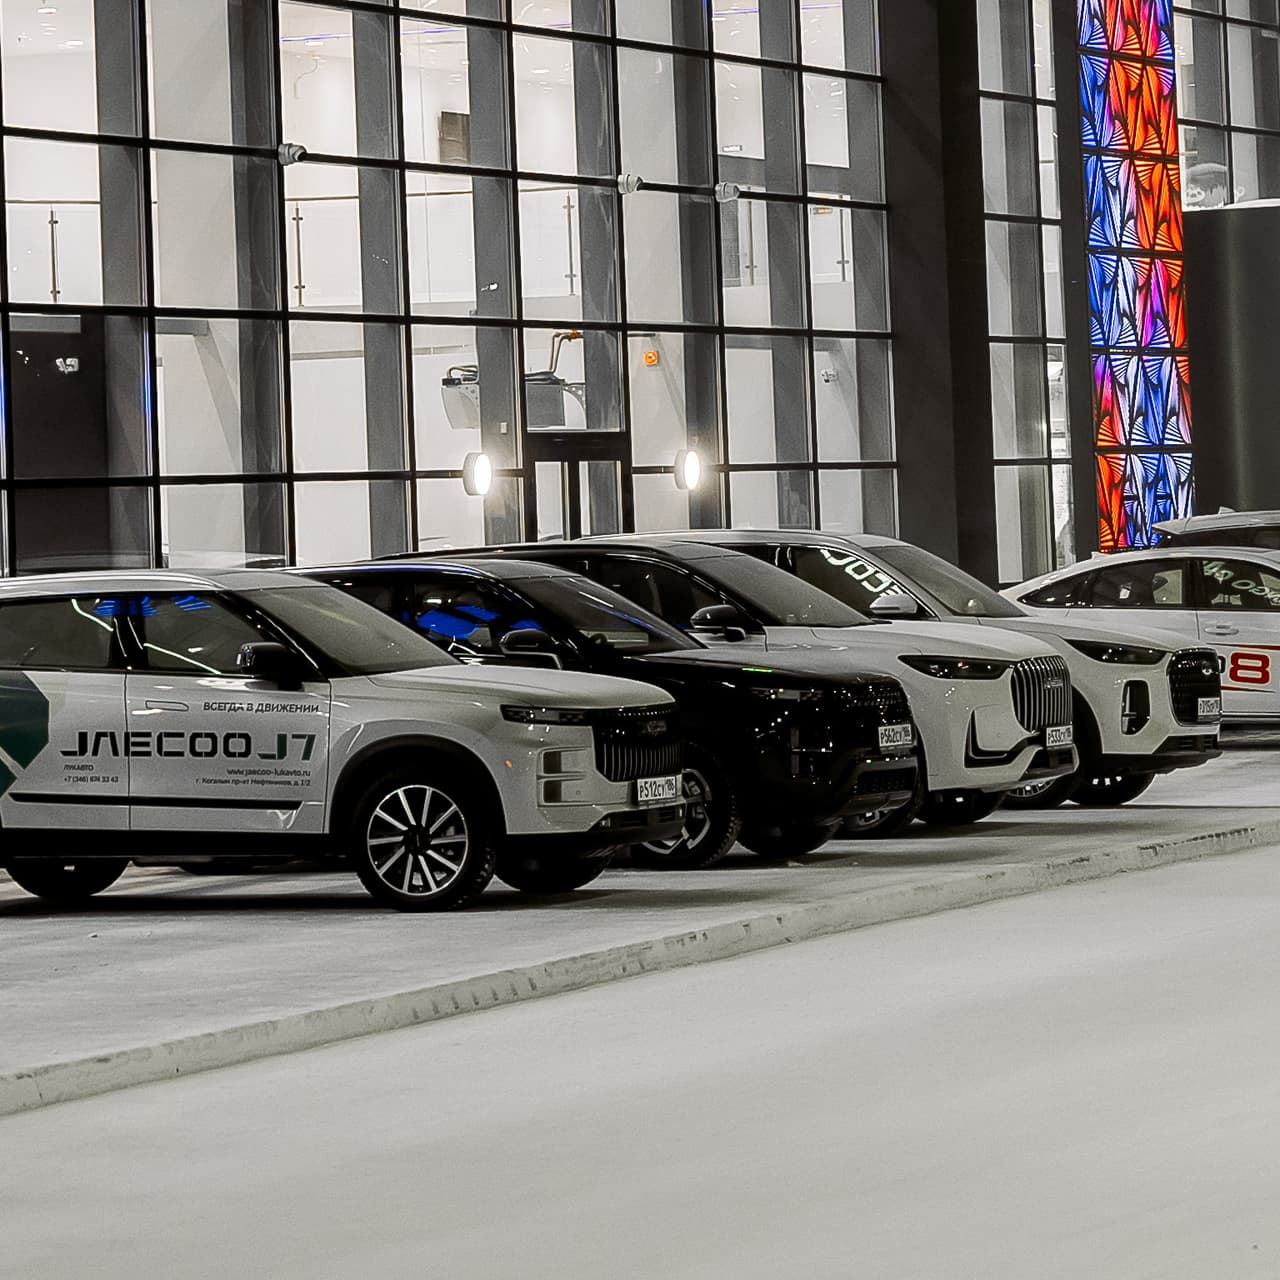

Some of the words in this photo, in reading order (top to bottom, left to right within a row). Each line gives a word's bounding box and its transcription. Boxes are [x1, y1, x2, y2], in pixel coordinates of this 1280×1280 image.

[1229, 652, 1271, 685] 8
[203, 701, 245, 713] ВСЕГДА
[246, 703, 254, 712] В
[255, 702, 320, 713] ДВИЖЕНИИ
[59, 731, 252, 758] JAECOO
[257, 733, 317, 761] J7
